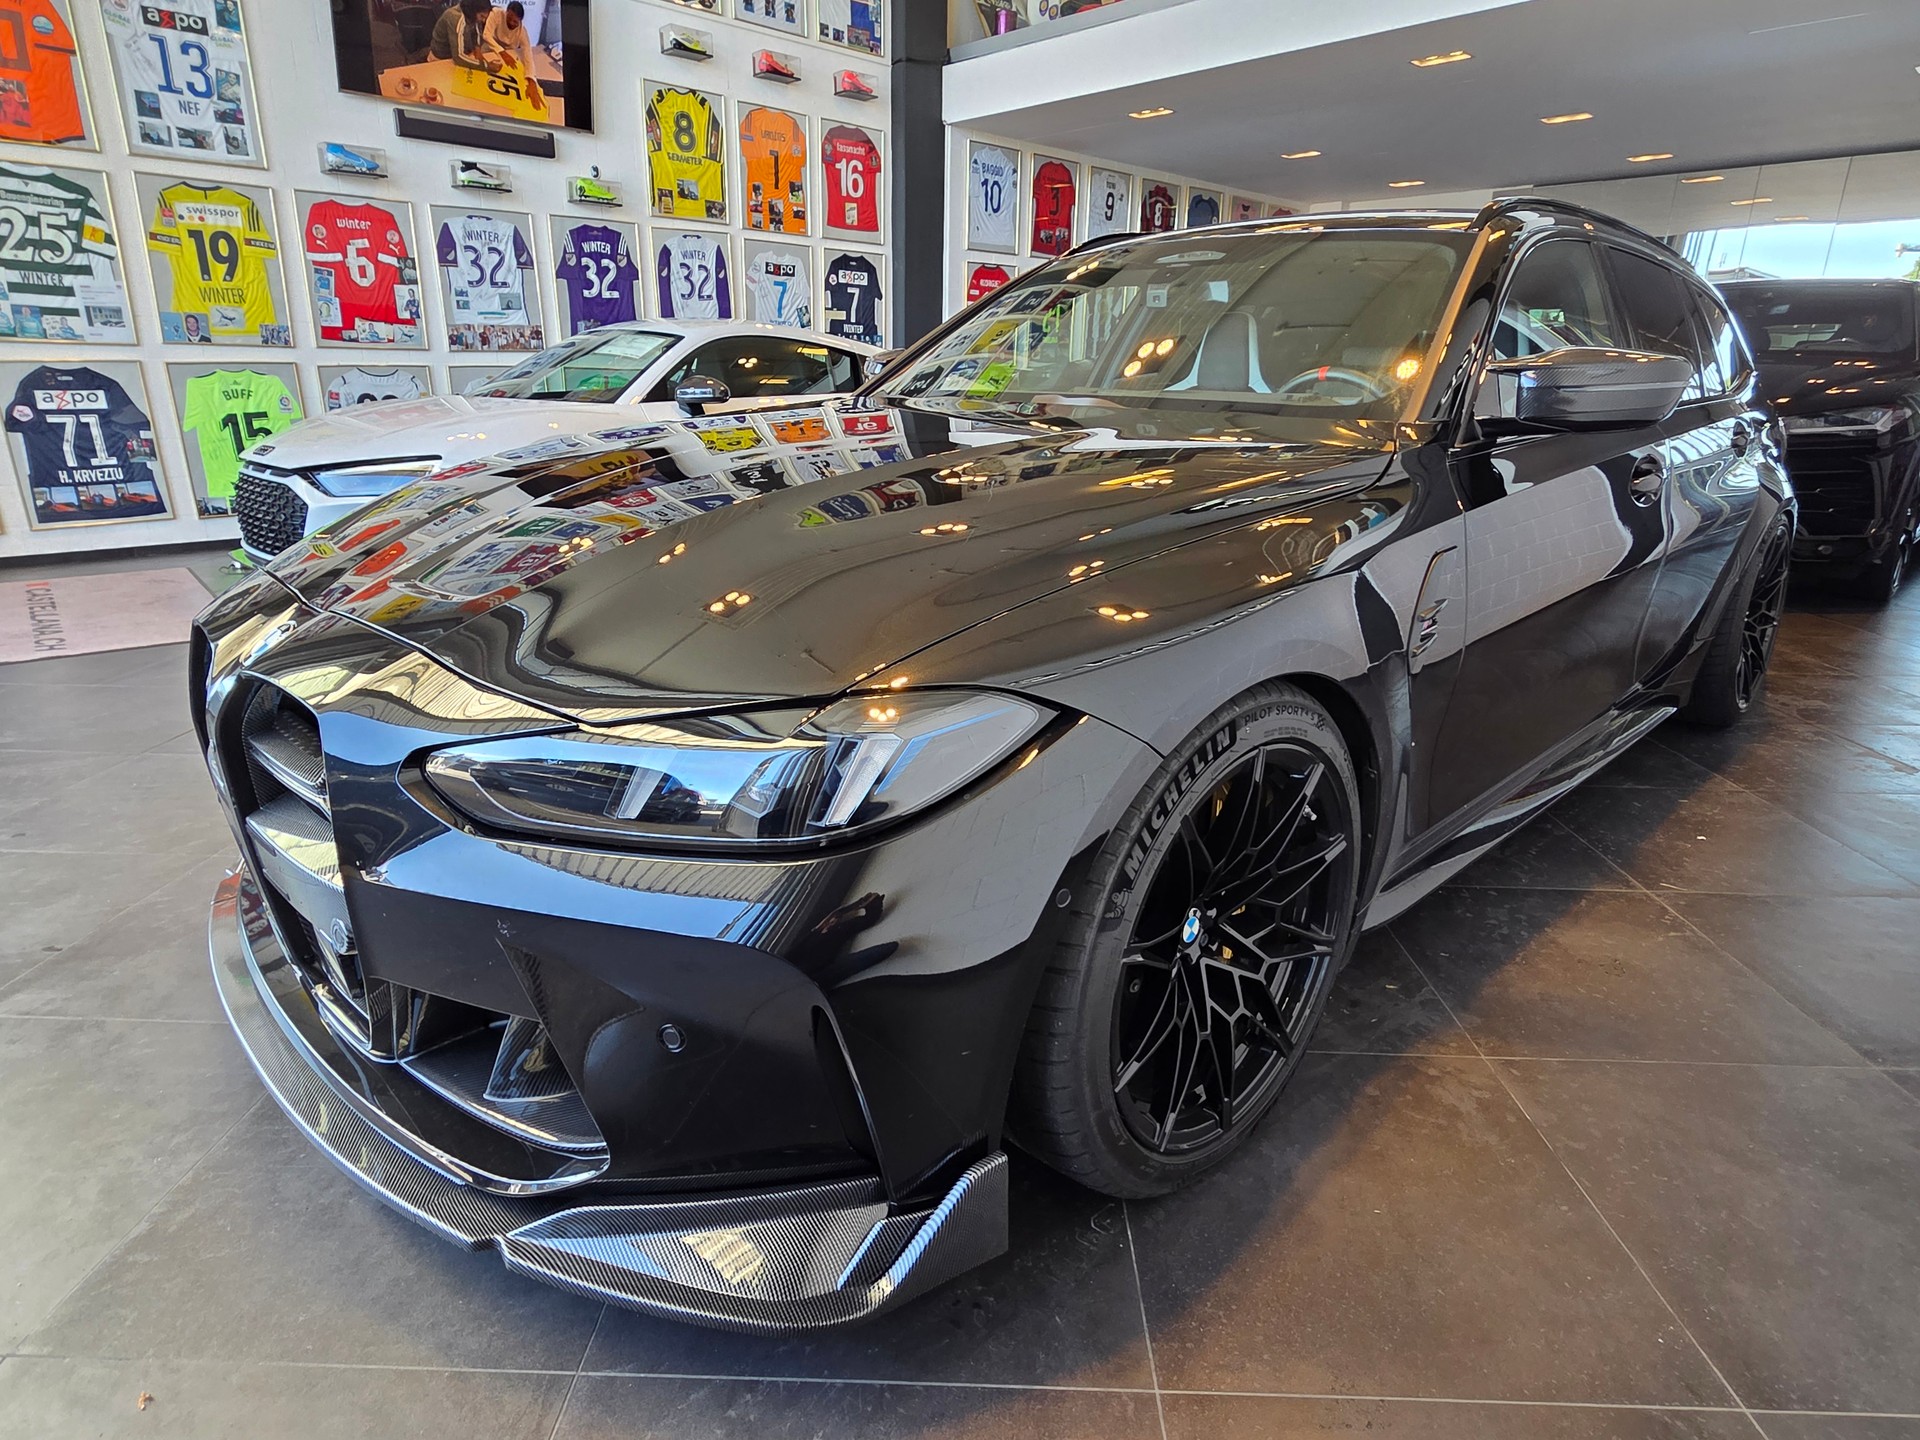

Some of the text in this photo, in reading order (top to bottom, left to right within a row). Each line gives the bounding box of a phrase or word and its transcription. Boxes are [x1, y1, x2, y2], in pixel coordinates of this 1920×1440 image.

[149, 34, 215, 98] 13
[179, 100, 201, 115] NEF
[674, 110, 697, 153] 8
[769, 150, 779, 189] 1
[835, 158, 865, 198] 16
[186, 206, 240, 219] swisspor
[981, 178, 1002, 213] 10
[1105, 192, 1115, 221] 9
[336, 217, 372, 230] winter
[1154, 203, 1162, 226] 8
[0, 206, 74, 264] 25
[464, 230, 500, 243] WINTER
[581, 241, 611, 254] WINTER
[187, 229, 239, 282] 19
[345, 238, 376, 287] 6
[463, 245, 511, 288] 32
[681, 250, 706, 261] WINTER
[20, 270, 64, 286] WINTER
[198, 287, 246, 304] WINTER
[581, 257, 620, 299] 32
[679, 262, 713, 301] 32
[773, 280, 787, 318] 7
[847, 287, 860, 322] 7
[222, 388, 254, 400] BUFF
[45, 414, 118, 467] 71
[219, 411, 274, 462] 15
[58, 467, 124, 484] H. KRYEZIU
[1243, 706, 1273, 726] PILOT
[1275, 705, 1305, 717] SPORT
[1123, 725, 1231, 881] MICHELIN
